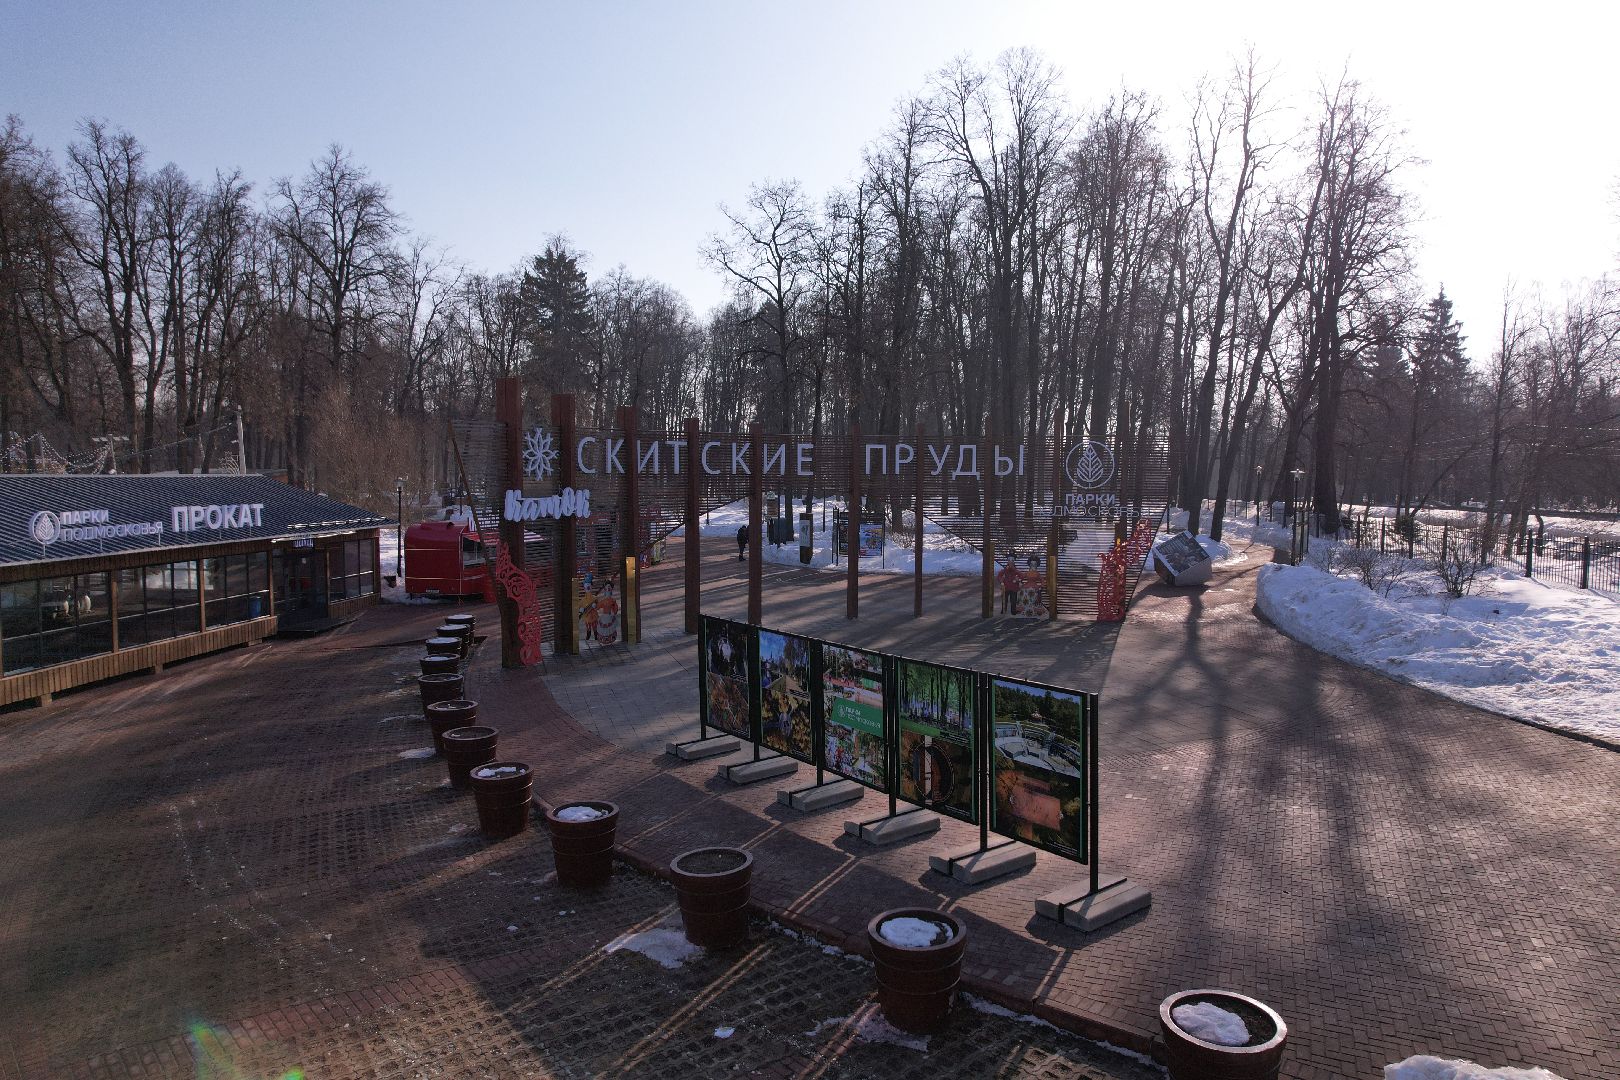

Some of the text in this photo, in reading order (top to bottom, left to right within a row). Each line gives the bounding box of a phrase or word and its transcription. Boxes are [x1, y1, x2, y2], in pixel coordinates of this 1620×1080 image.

[577, 437, 1025, 481] СКИТСКИЕ ПРУДЫ
[1065, 493, 1116, 506] ПАРКИ
[61, 509, 109, 525] ПАРКИ
[172, 503, 264, 532] ПРОКАТ
[61, 521, 163, 541] ПОДМОСКОВЬЯ
